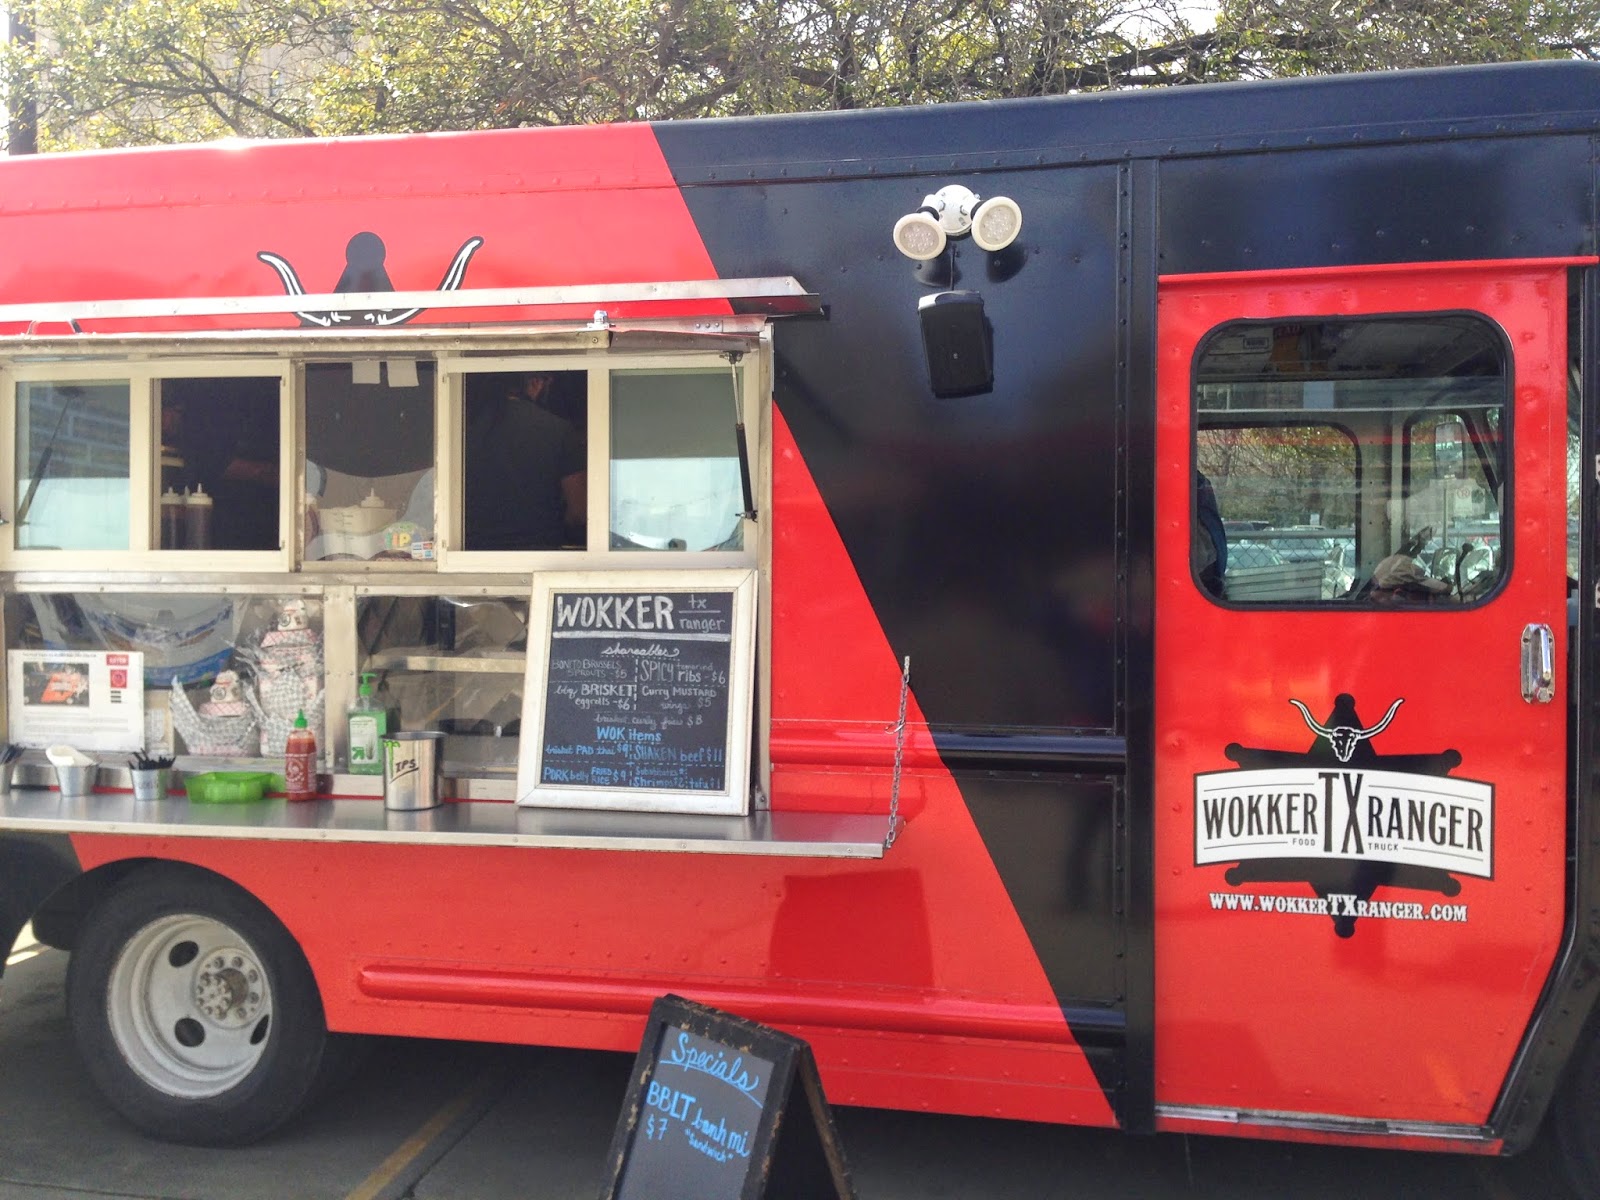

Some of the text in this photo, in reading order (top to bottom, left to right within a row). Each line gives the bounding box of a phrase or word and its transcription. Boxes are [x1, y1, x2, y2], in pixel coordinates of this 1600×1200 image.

[556, 595, 675, 630] WOKKER
[679, 618, 726, 633] ranger
[602, 642, 680, 657] shareables
[640, 659, 674, 682] SPICY
[678, 669, 702, 682] ribs
[581, 683, 635, 697] BRISKET
[641, 685, 717, 700] Curry MUSTARD
[596, 726, 662, 742] WOK items
[576, 744, 595, 755] PAD
[1203, 772, 1484, 854] WOKKER TX RANGER
[1292, 838, 1399, 851] FOOD TRUCK
[672, 1032, 759, 1092] Specials
[646, 1080, 696, 1121] BBLT
